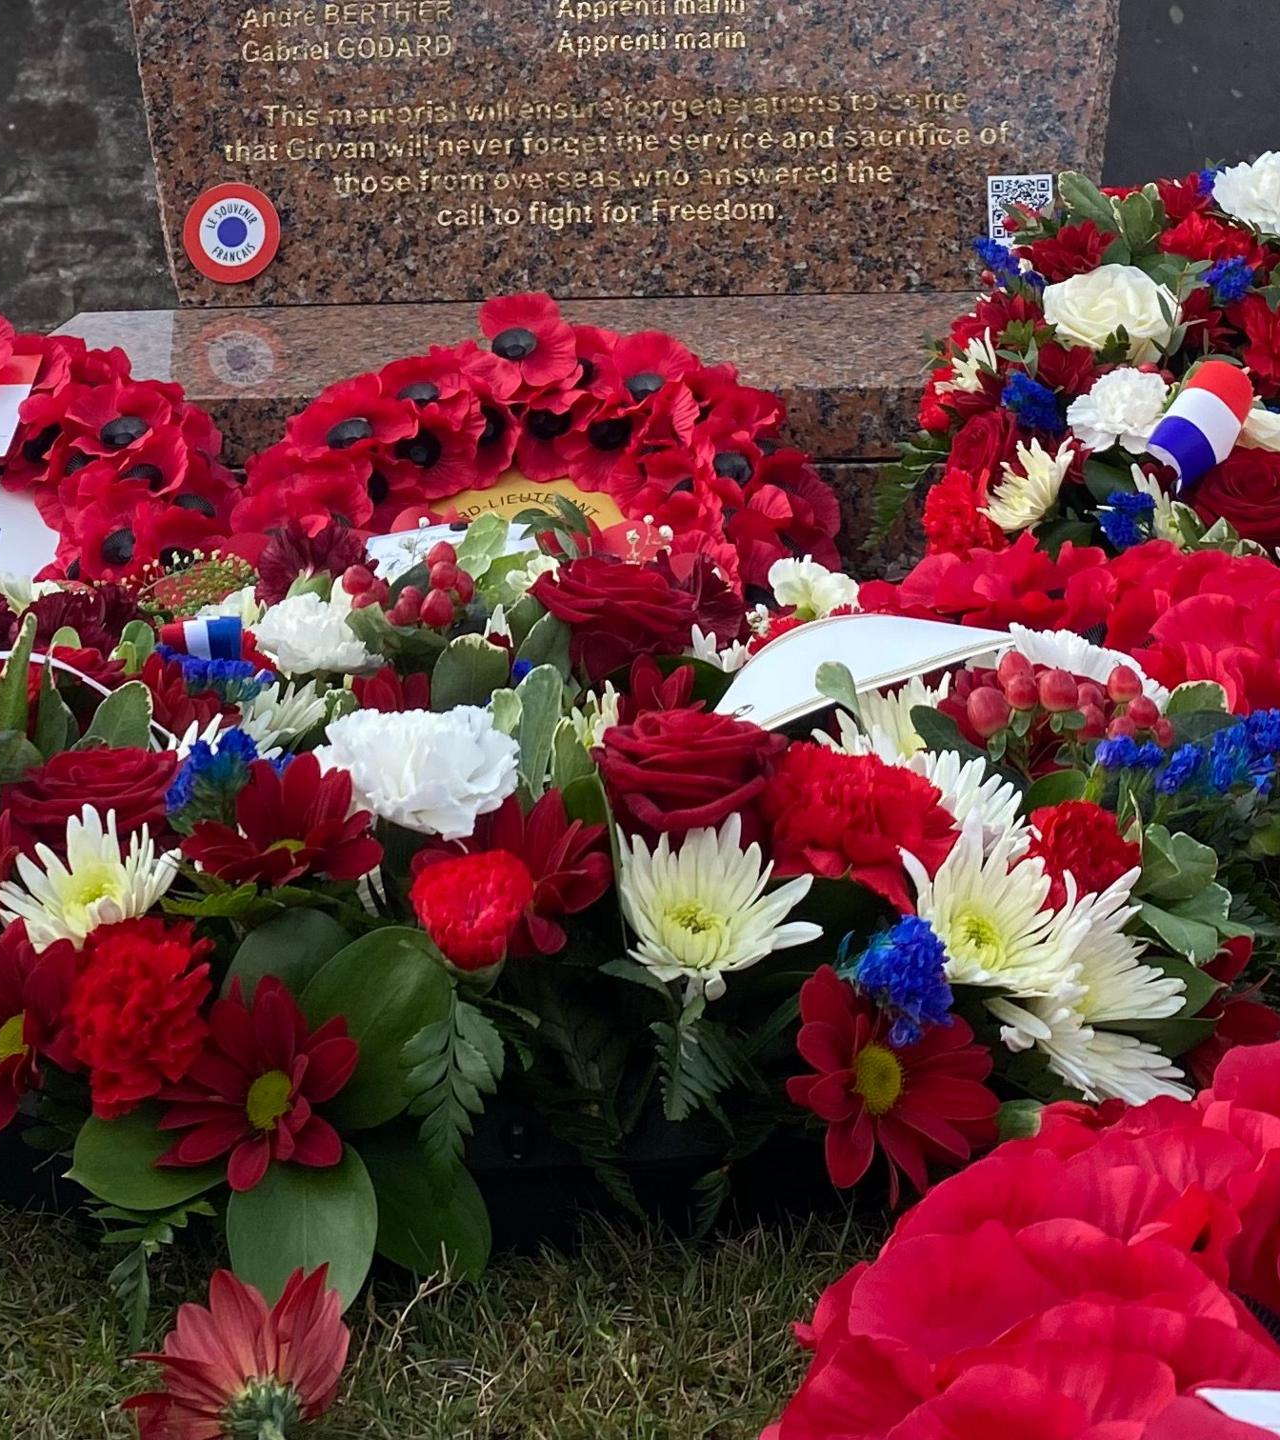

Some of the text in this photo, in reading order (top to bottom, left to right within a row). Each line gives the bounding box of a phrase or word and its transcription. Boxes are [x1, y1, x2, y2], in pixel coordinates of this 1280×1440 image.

[241, 34, 453, 63] Gabriel GODARD
[263, 102, 320, 128] This
[327, 99, 457, 127] memorial
[464, 100, 513, 123] will
[519, 100, 613, 122] ensure
[619, 96, 664, 120] for
[670, 95, 841, 123] generations
[850, 89, 878, 112] to
[223, 119, 1011, 163] that Girvan will never forget the service and sacrifice of
[332, 159, 894, 196] those from overseas who answered the
[206, 202, 258, 230] LE SOUVENIR
[436, 200, 484, 228] call
[492, 203, 520, 226] to
[528, 199, 593, 231] fight
[600, 198, 641, 225] for
[211, 242, 256, 263] FRANÇAIS
